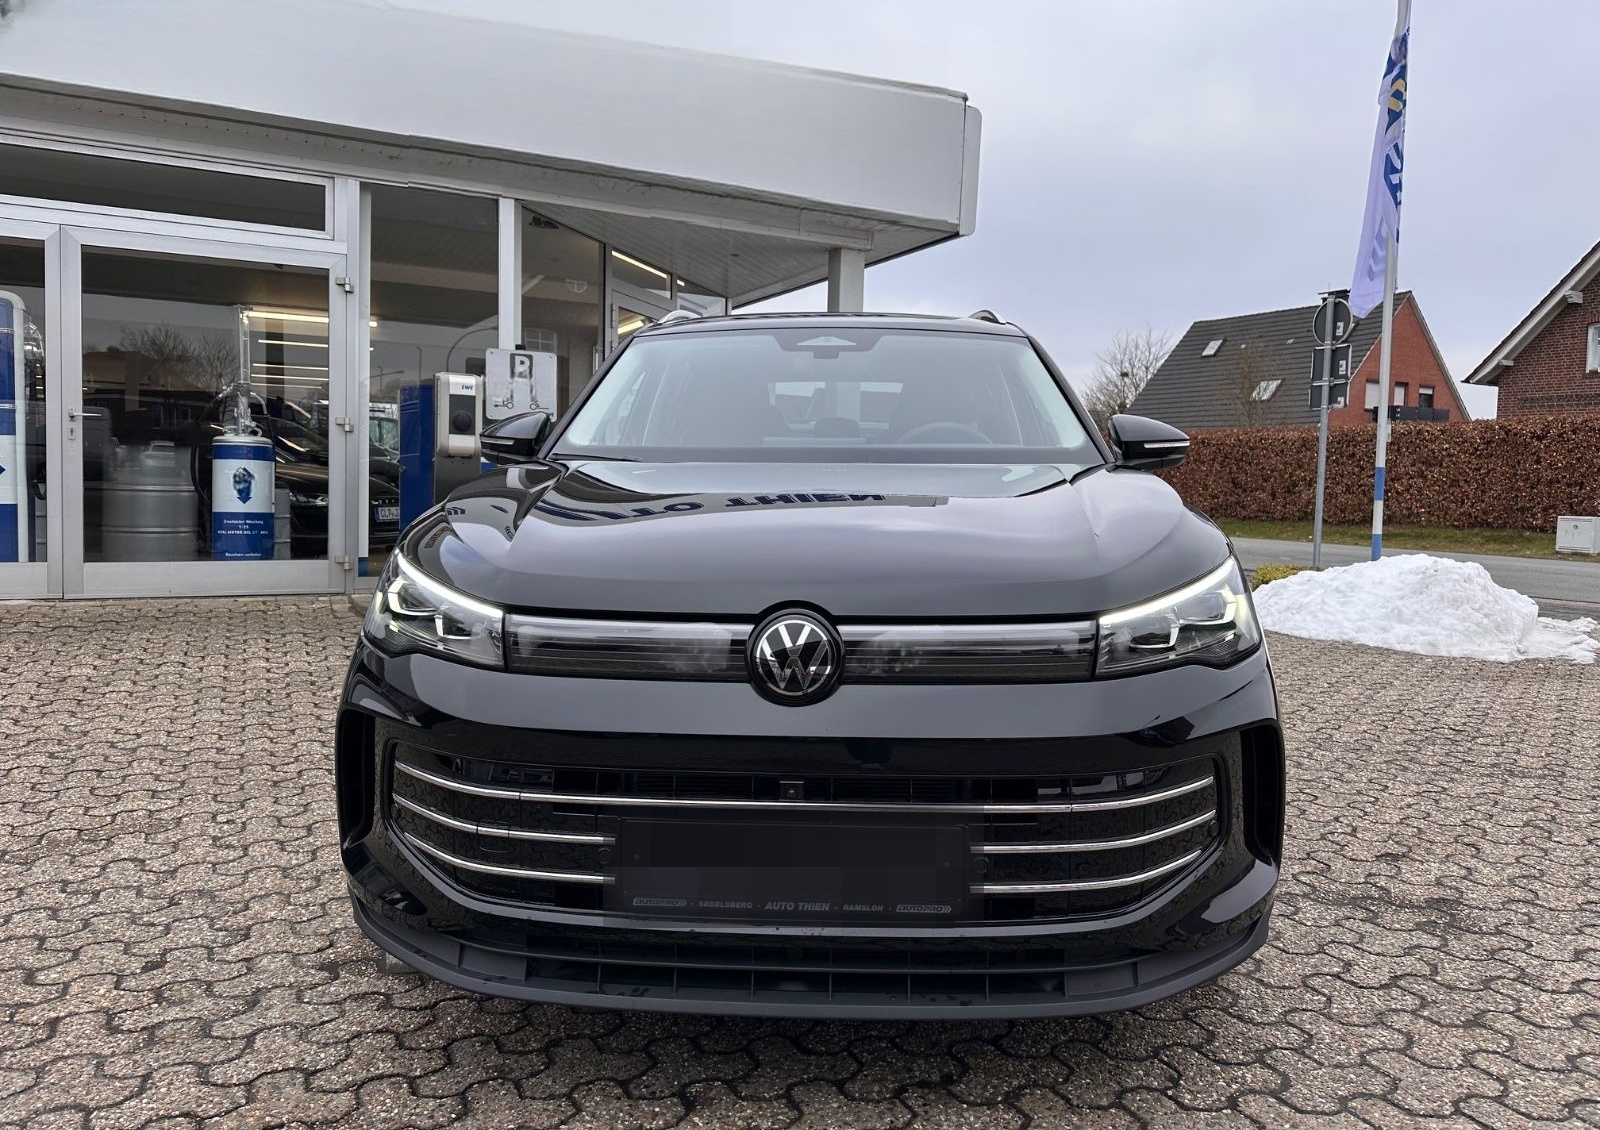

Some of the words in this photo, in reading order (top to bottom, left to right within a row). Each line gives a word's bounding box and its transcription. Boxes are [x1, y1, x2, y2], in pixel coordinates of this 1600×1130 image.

[698, 900, 753, 909] SEDELSBERG
[764, 901, 795, 910] AUTO
[798, 902, 830, 911] THIEN
[842, 904, 884, 912] RAMSLOH
